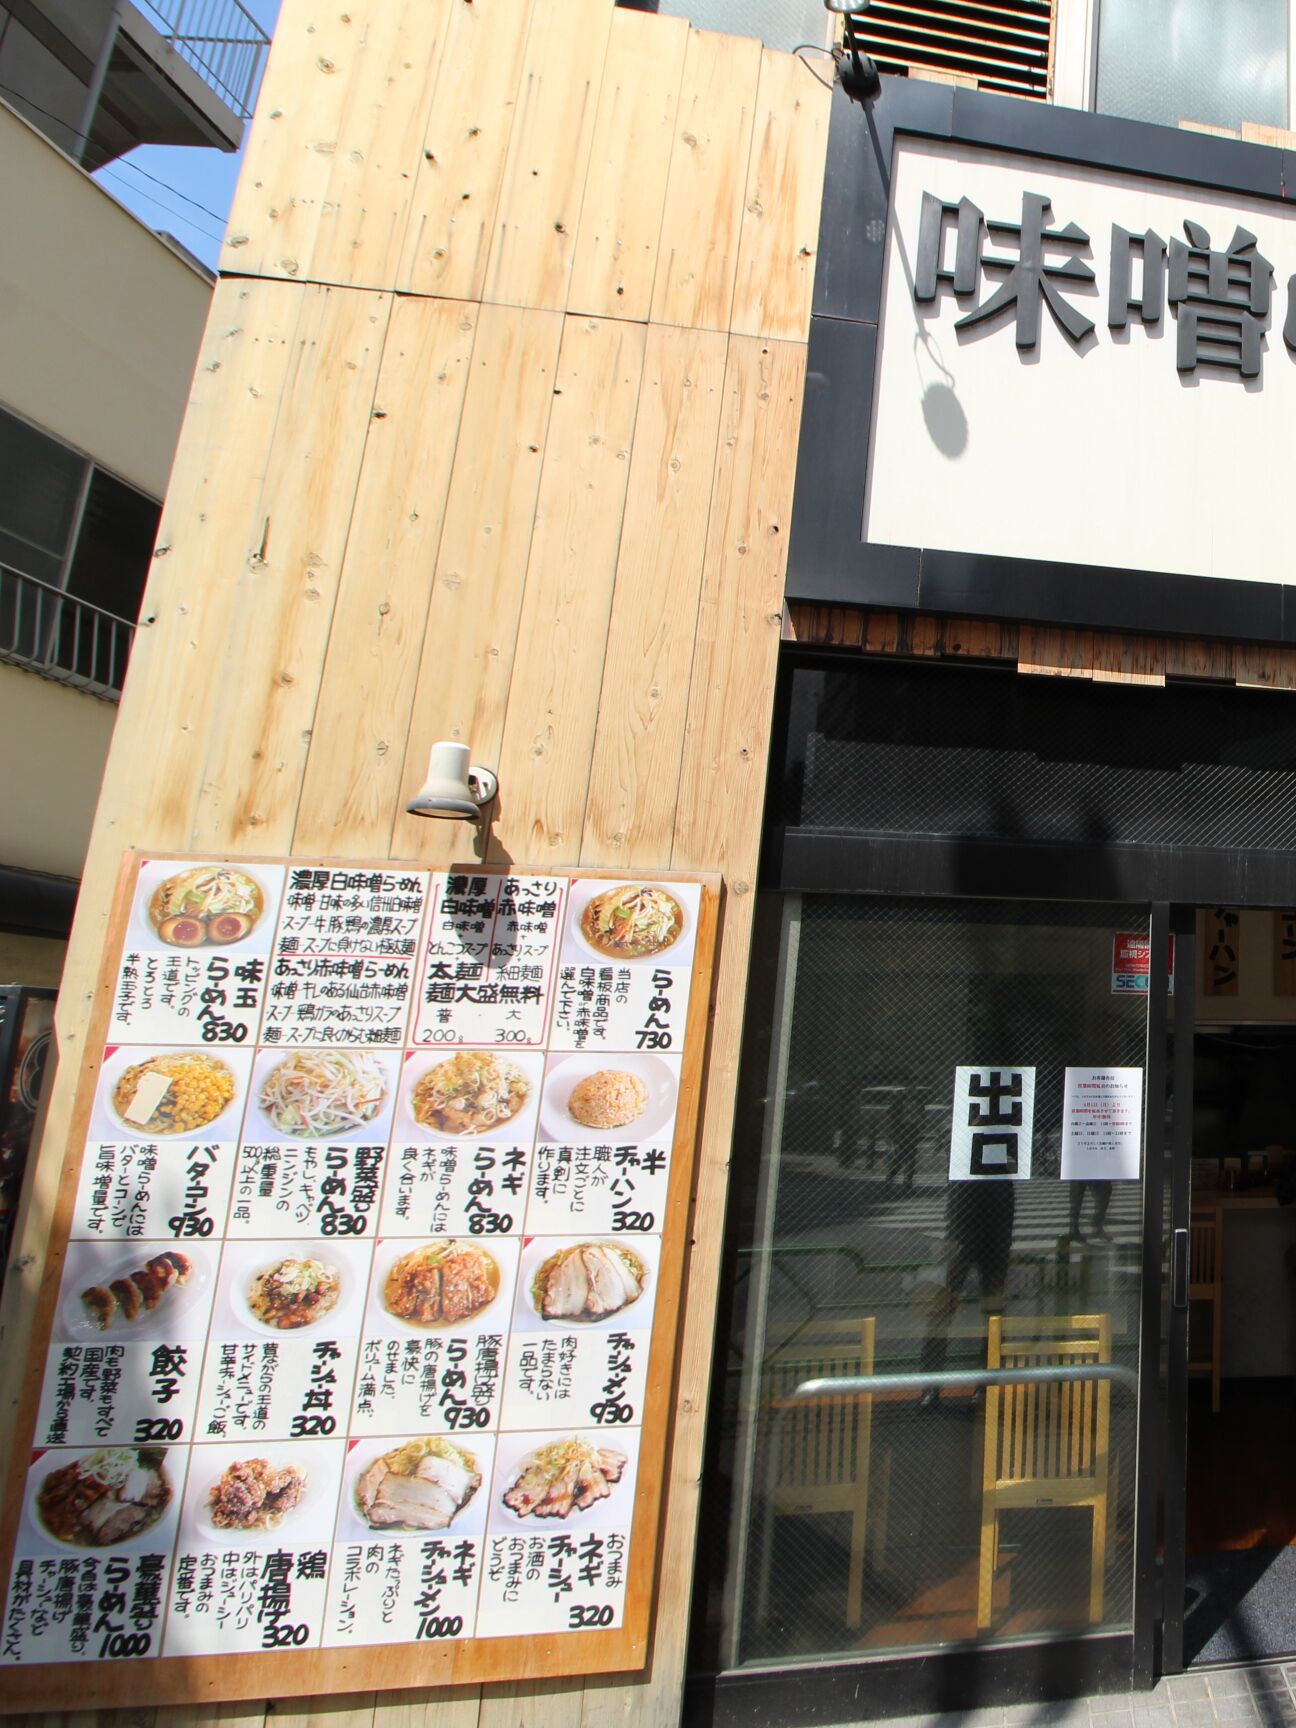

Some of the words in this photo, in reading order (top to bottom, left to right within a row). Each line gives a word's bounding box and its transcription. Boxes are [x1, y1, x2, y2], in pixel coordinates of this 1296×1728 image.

[289, 869, 423, 894] 濃厚白味噌らーめん
[445, 876, 487, 895] 濃厚
[504, 878, 557, 896] あっさり
[440, 900, 495, 915] 白味噌
[442, 920, 485, 932] 白味噌
[498, 901, 557, 916] 赤味噌
[507, 921, 548, 933] 赤味噌
[274, 958, 409, 980] あっさり赤味噌らーめん
[430, 962, 483, 980] 太麺
[1209, 909, 1239, 985] ャーハン
[178, 957, 201, 1017] トッピングの
[197, 956, 229, 1022] らーめん
[234, 958, 263, 1009] 味玉
[425, 983, 544, 1004] 麺大盛無料
[496, 964, 544, 982] 細麺
[614, 969, 631, 1004] 当店の
[506, 1009, 521, 1021] 大
[644, 970, 673, 1030] らーめん
[201, 1021, 248, 1043] 830
[635, 1031, 672, 1049] 730
[968, 1071, 1022, 1175] 出口
[110, 1144, 140, 1227] バターとコーンで
[184, 1145, 220, 1218] バターコーン
[258, 1146, 281, 1198] 総重量
[276, 1148, 299, 1212] ニンジンの
[316, 1147, 348, 1215] らーめん
[350, 1147, 385, 1213] 野菜盛り
[419, 1147, 436, 1182] ネギが
[464, 1147, 496, 1214] らーめん
[502, 1146, 528, 1196] ネギ
[552, 1146, 572, 1194] 真剣に
[570, 1146, 593, 1212] 注文ごとに
[591, 1146, 612, 1187] 職人が
[610, 1146, 641, 1209] チャーハン
[642, 1148, 667, 1175] 半
[126, 1144, 158, 1237] 味噌らーめんには
[430, 1146, 457, 1233] 味噌らーめんには
[168, 1217, 214, 1238] 930
[320, 1214, 368, 1236] 830
[468, 1214, 513, 1234] 830
[612, 1212, 654, 1231] 320
[149, 1344, 188, 1403] 餃子
[252, 1342, 280, 1431] 昔ながらの王道の
[302, 1341, 341, 1412] チャーシュー丼
[401, 1339, 422, 1385] 豪快に
[419, 1338, 443, 1417] 豚の唐揚げを
[438, 1338, 467, 1407] らーめん
[536, 1339, 558, 1401] たまらない
[555, 1335, 576, 1399] 肉好きには
[602, 1332, 635, 1403] チャーシューメン
[96, 1345, 124, 1437] 肉も野菜もすべて
[590, 1403, 633, 1424] 930
[134, 1418, 183, 1442] 320
[290, 1416, 336, 1437] 320
[444, 1407, 491, 1430] 930
[195, 1552, 218, 1613] おつまみの
[296, 1550, 327, 1579] 鶏
[365, 1544, 384, 1574] 肉の
[381, 1543, 402, 1624] ネギたっぷりと
[414, 1540, 451, 1617] チャーシューメン
[452, 1540, 476, 1587] ネギ
[489, 1536, 507, 1582] どうぞ
[503, 1537, 526, 1603] おつまみに
[526, 1536, 546, 1581] お酒の
[548, 1535, 577, 1603] チャーシュー
[578, 1533, 604, 1587] ネギ
[605, 1533, 625, 1589] おつまみ
[96, 1557, 132, 1633] らーめん
[216, 1550, 240, 1630] 中はジューシー
[236, 1551, 262, 1630] 外はパリパリ
[257, 1549, 293, 1625] 唐揚げ
[262, 1624, 309, 1648] 320
[416, 1616, 463, 1639] 1000
[568, 1605, 614, 1628] 320
[98, 1633, 151, 1658] 1000
